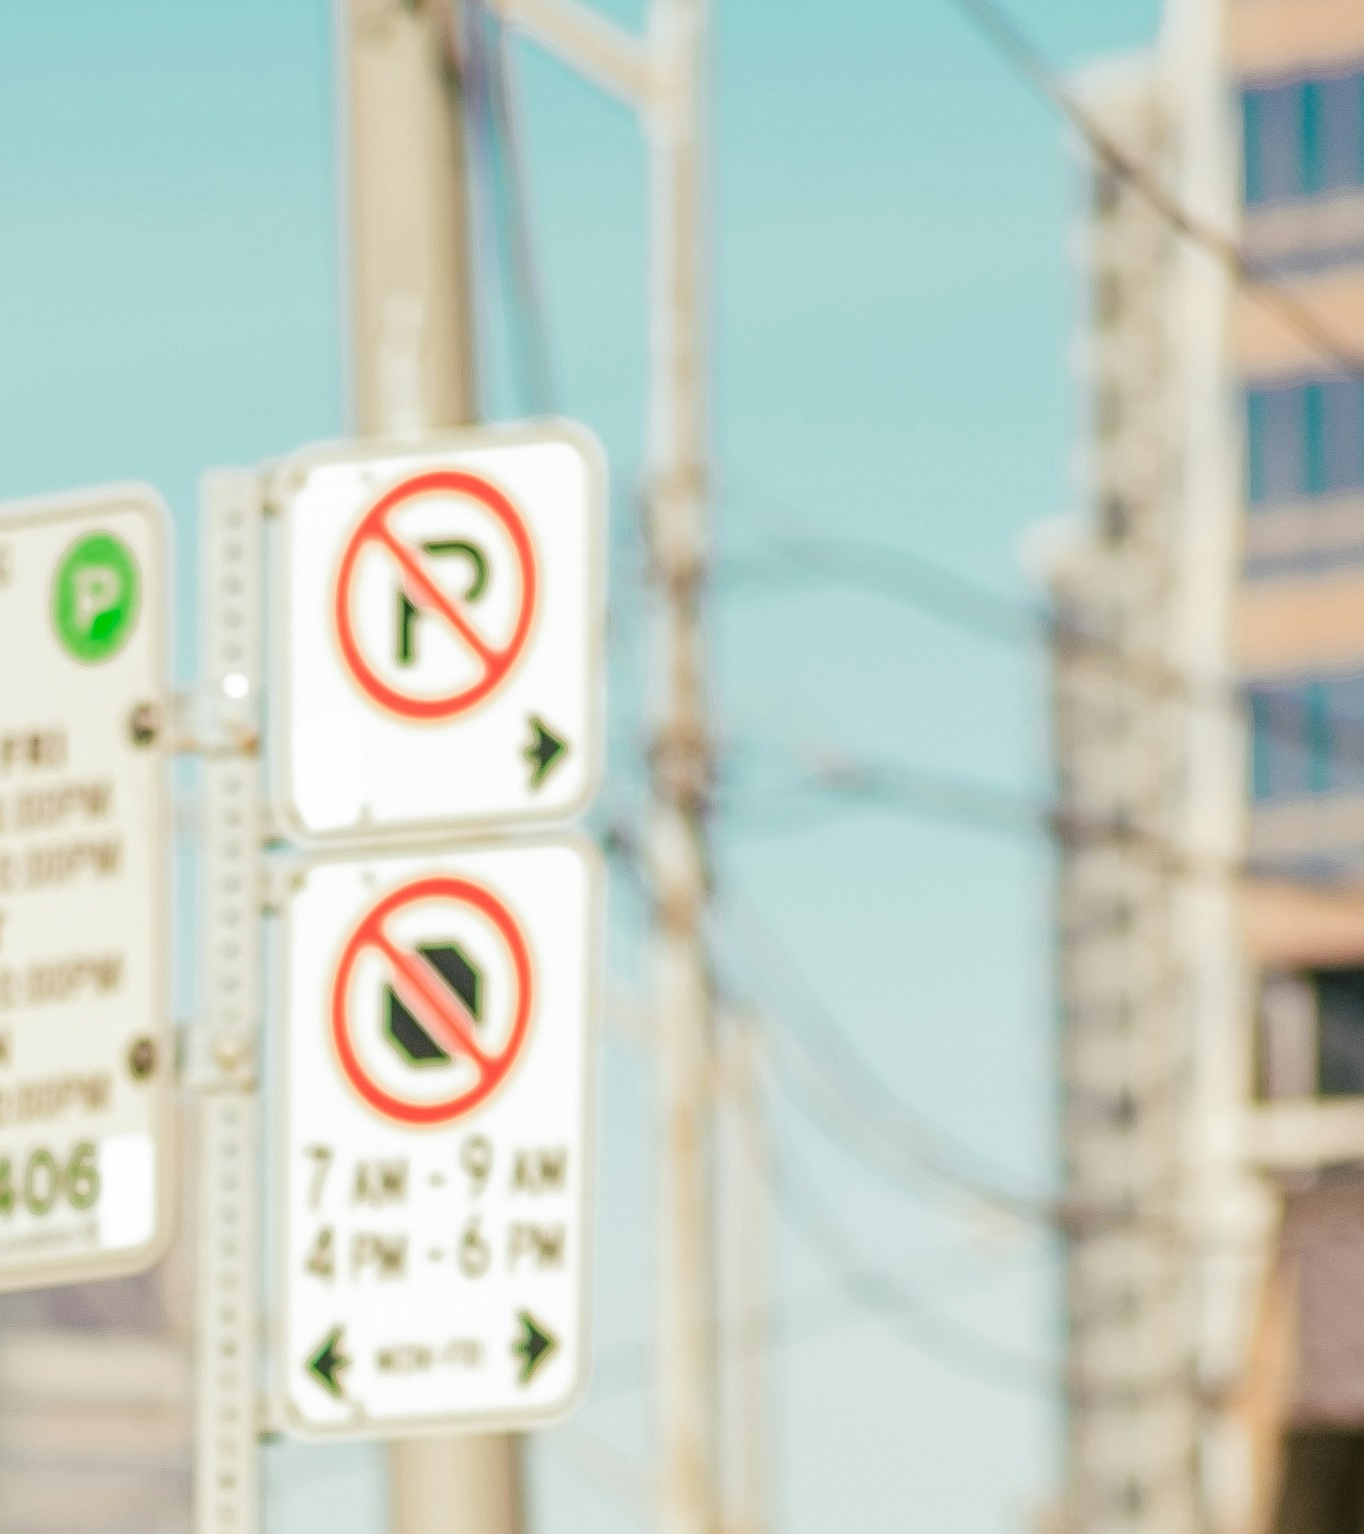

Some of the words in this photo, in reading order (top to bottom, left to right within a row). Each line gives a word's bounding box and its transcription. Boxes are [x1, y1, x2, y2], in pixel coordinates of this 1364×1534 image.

[305, 1143, 335, 1211] 7
[460, 1133, 493, 1196] 9
[305, 1221, 335, 1284] 4
[350, 1231, 409, 1283] PM
[457, 1214, 491, 1280] 6
[507, 1220, 565, 1273] PM
